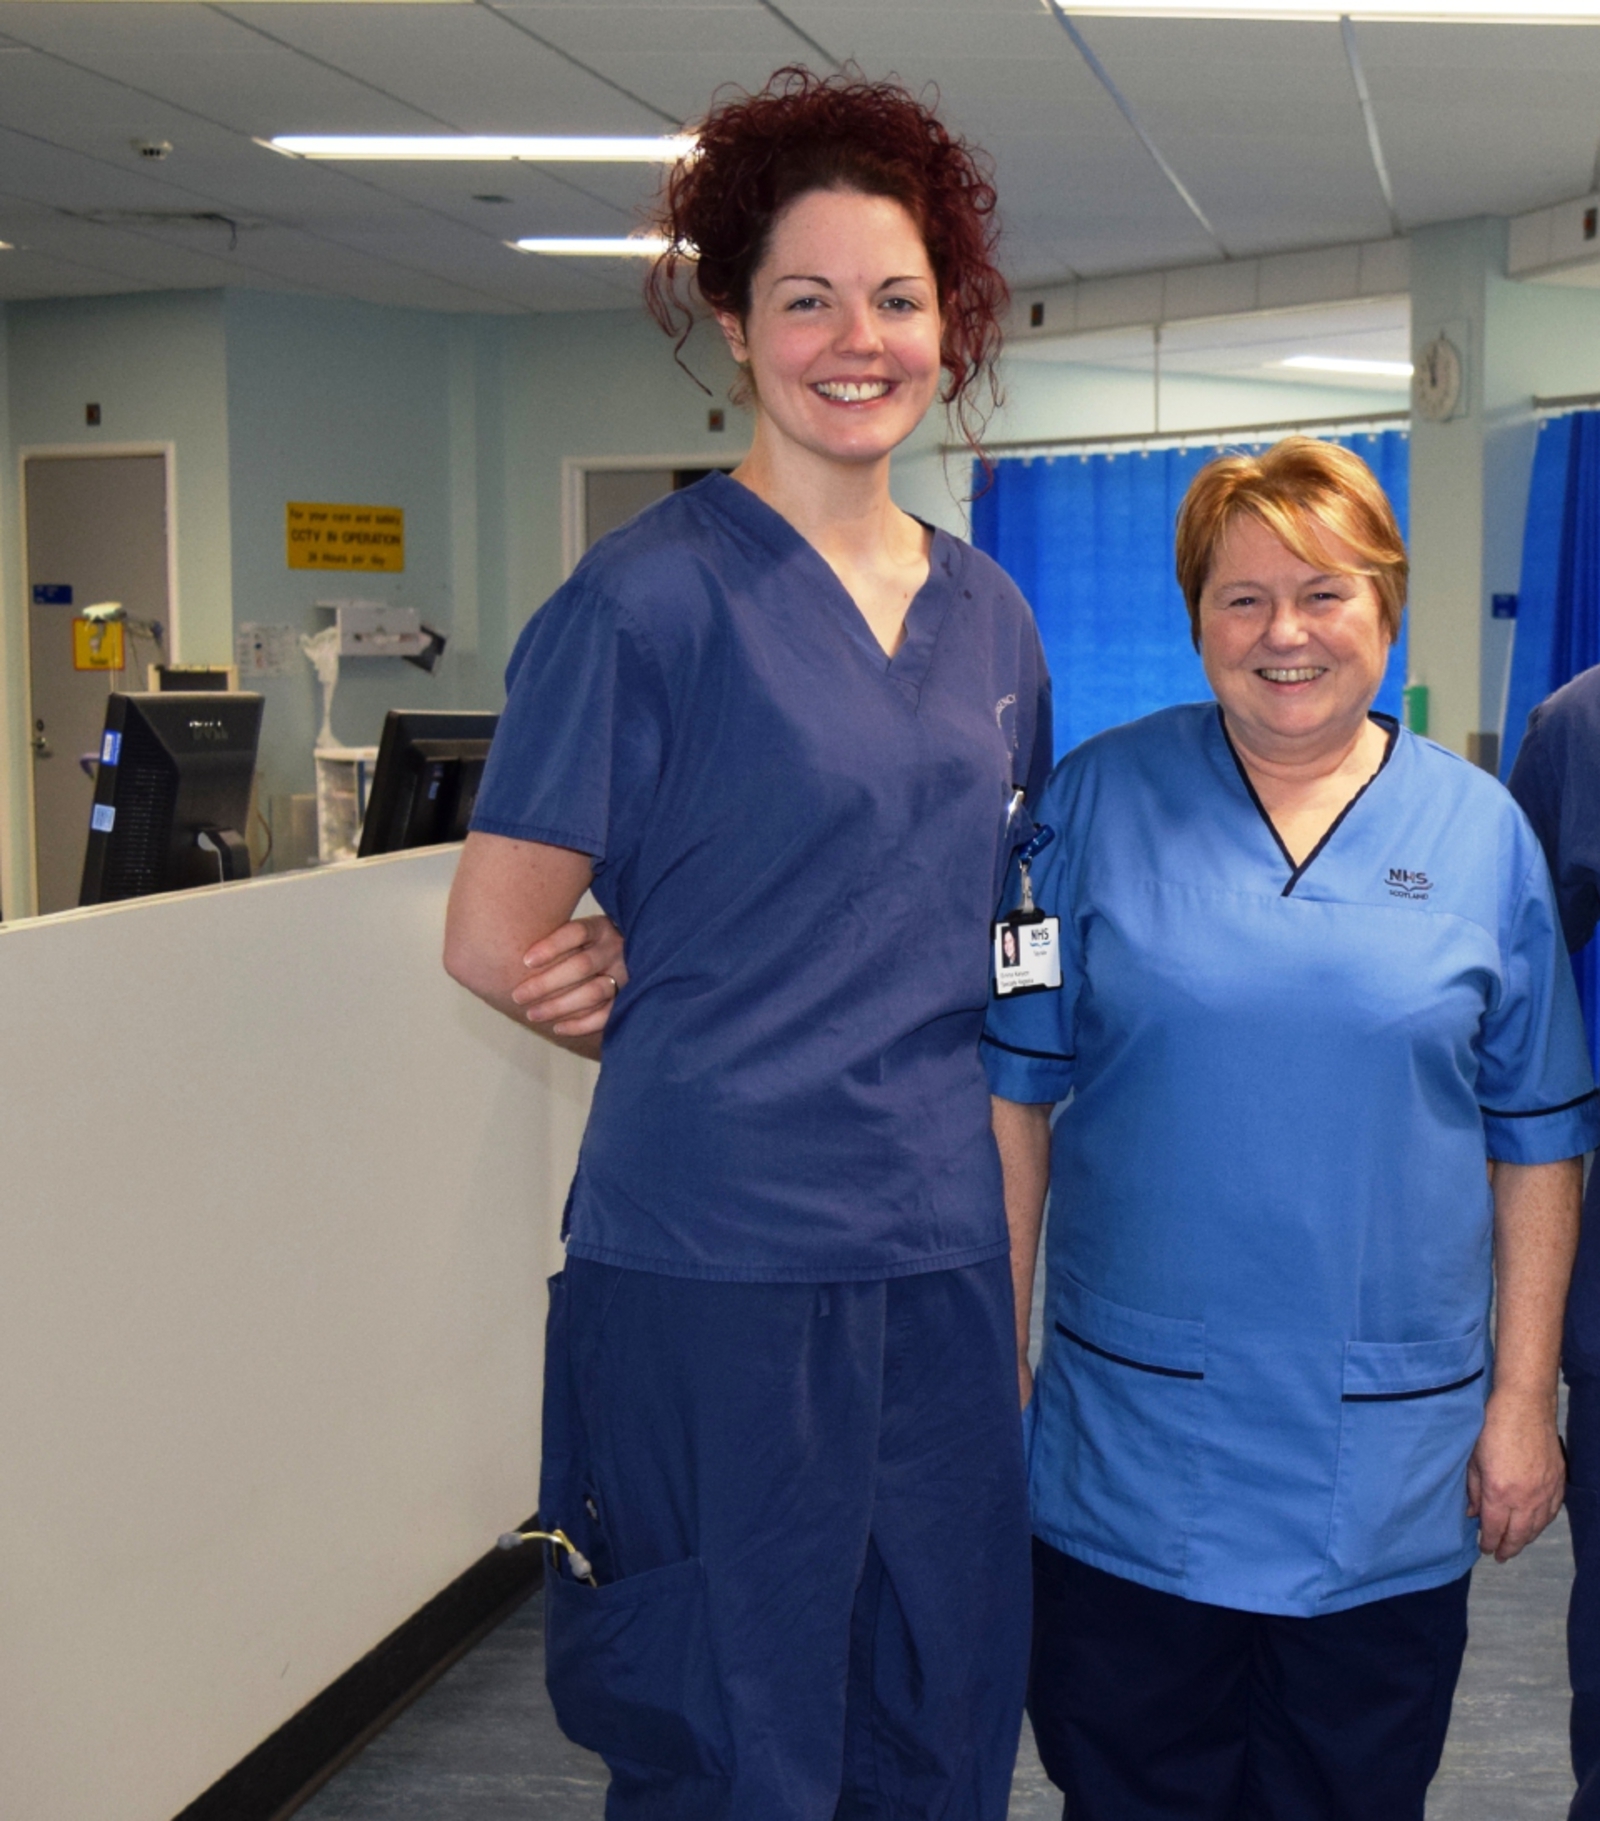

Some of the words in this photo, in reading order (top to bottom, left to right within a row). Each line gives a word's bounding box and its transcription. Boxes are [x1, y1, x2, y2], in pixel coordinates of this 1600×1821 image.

[291, 528, 320, 542] CCTV
[342, 531, 400, 545] OPERATION
[1389, 868, 1428, 884] NHS
[1389, 889, 1429, 900] SCOTLAND
[1031, 928, 1049, 941] NHS
